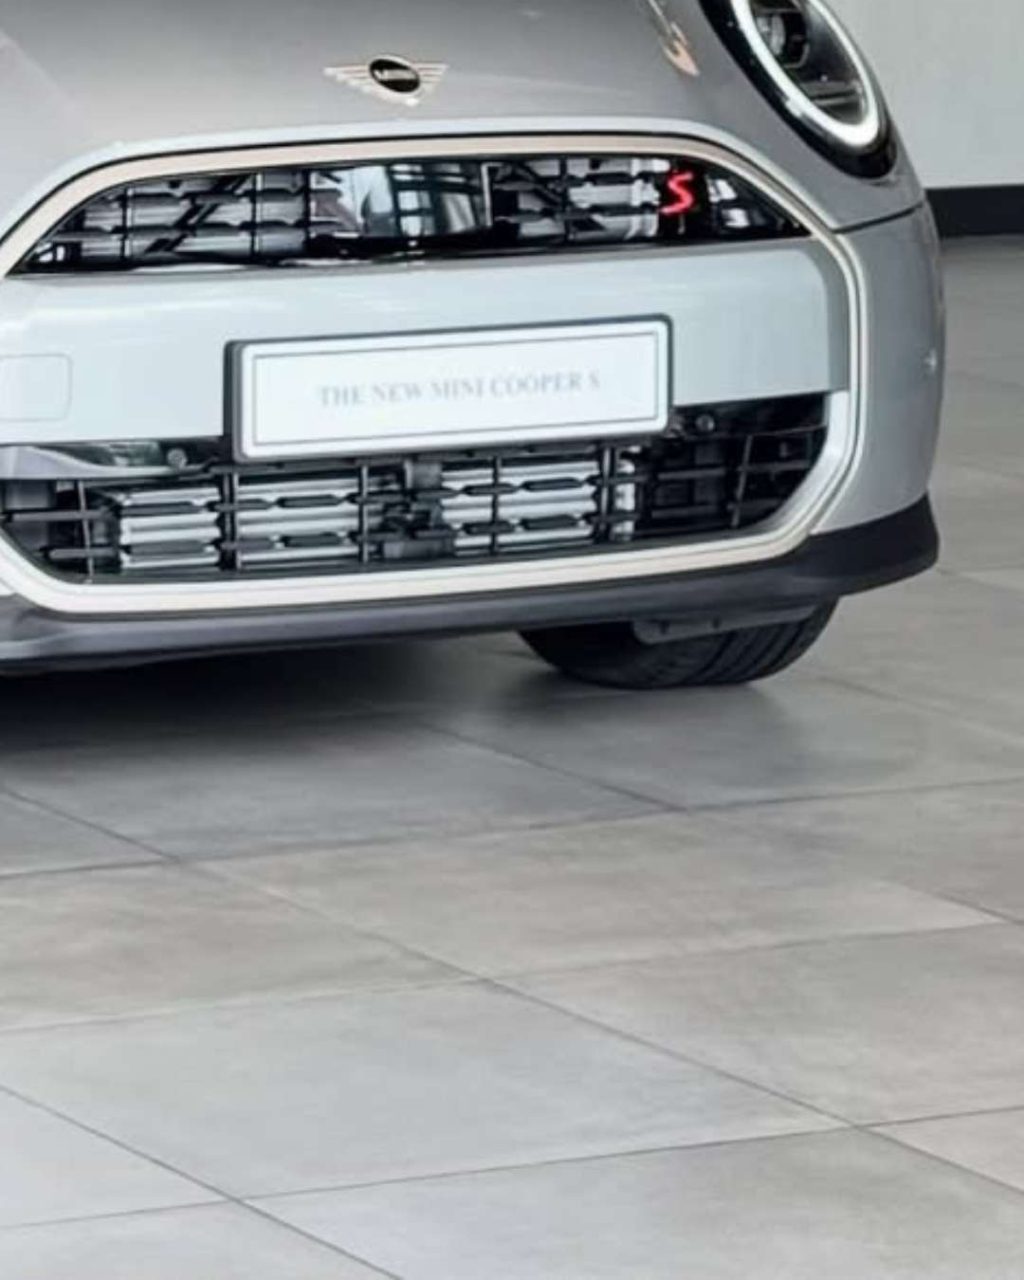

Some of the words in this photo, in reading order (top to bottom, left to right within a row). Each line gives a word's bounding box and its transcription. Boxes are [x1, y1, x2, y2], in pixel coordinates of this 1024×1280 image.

[660, 171, 694, 215] S
[319, 384, 364, 407] THE
[372, 380, 423, 403] NEW
[429, 376, 483, 399] MINI
[489, 371, 584, 399] COOPER
[589, 368, 602, 391] S
